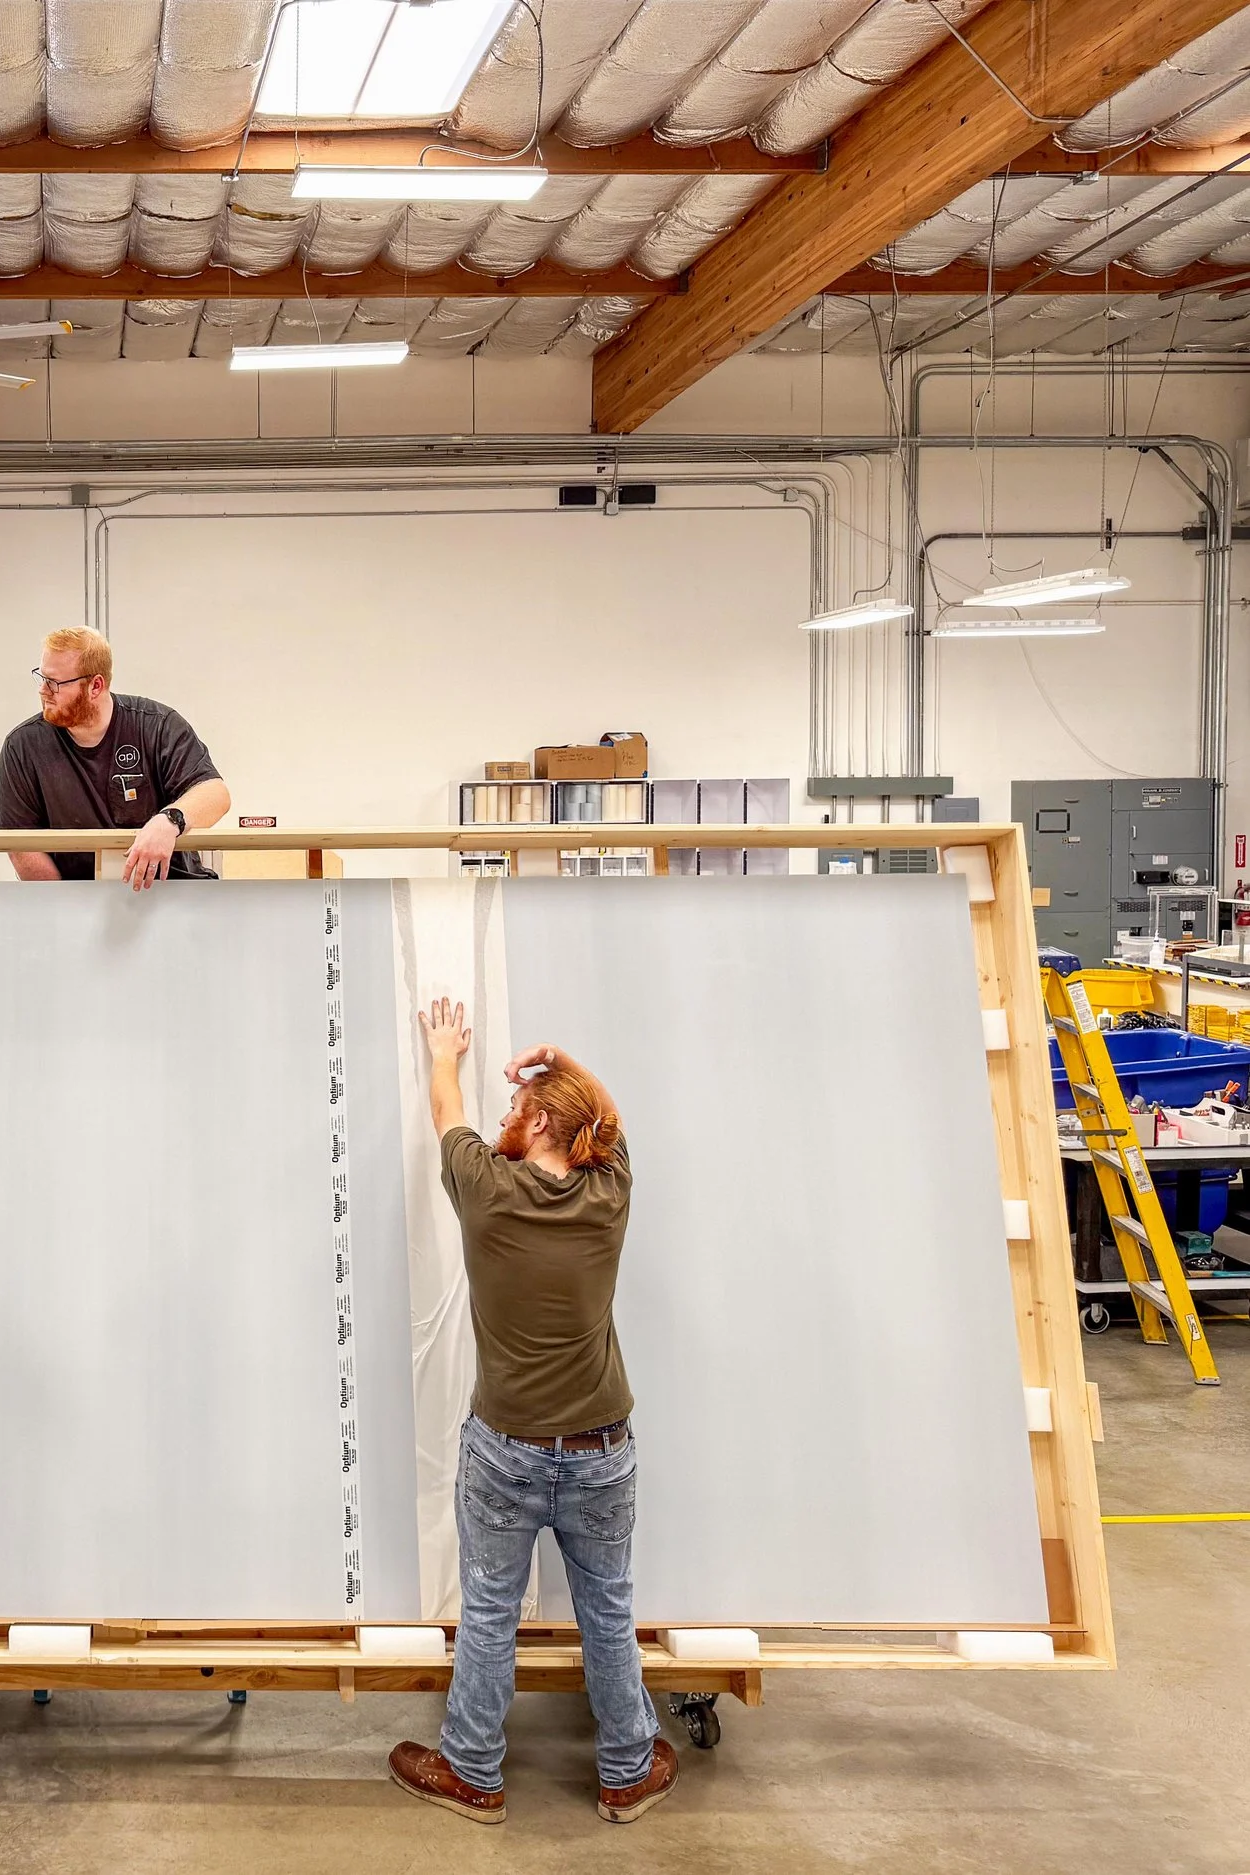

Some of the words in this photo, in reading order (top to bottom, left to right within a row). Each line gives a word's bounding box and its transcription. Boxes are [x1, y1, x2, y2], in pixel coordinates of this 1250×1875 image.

[118, 750, 136, 763] api
[325, 908, 333, 934] Optium
[326, 962, 335, 990] Optium
[328, 1020, 336, 1046] Optium
[330, 1076, 338, 1104] Optium
[332, 1134, 340, 1162] Optium
[334, 1194, 342, 1222] Optium
[336, 1254, 344, 1284] Optium
[338, 1314, 346, 1346] Optium
[340, 1378, 348, 1408] Optium
[342, 1442, 350, 1472] Optium
[344, 1506, 352, 1538] Optium
[346, 1572, 354, 1604] Optium
